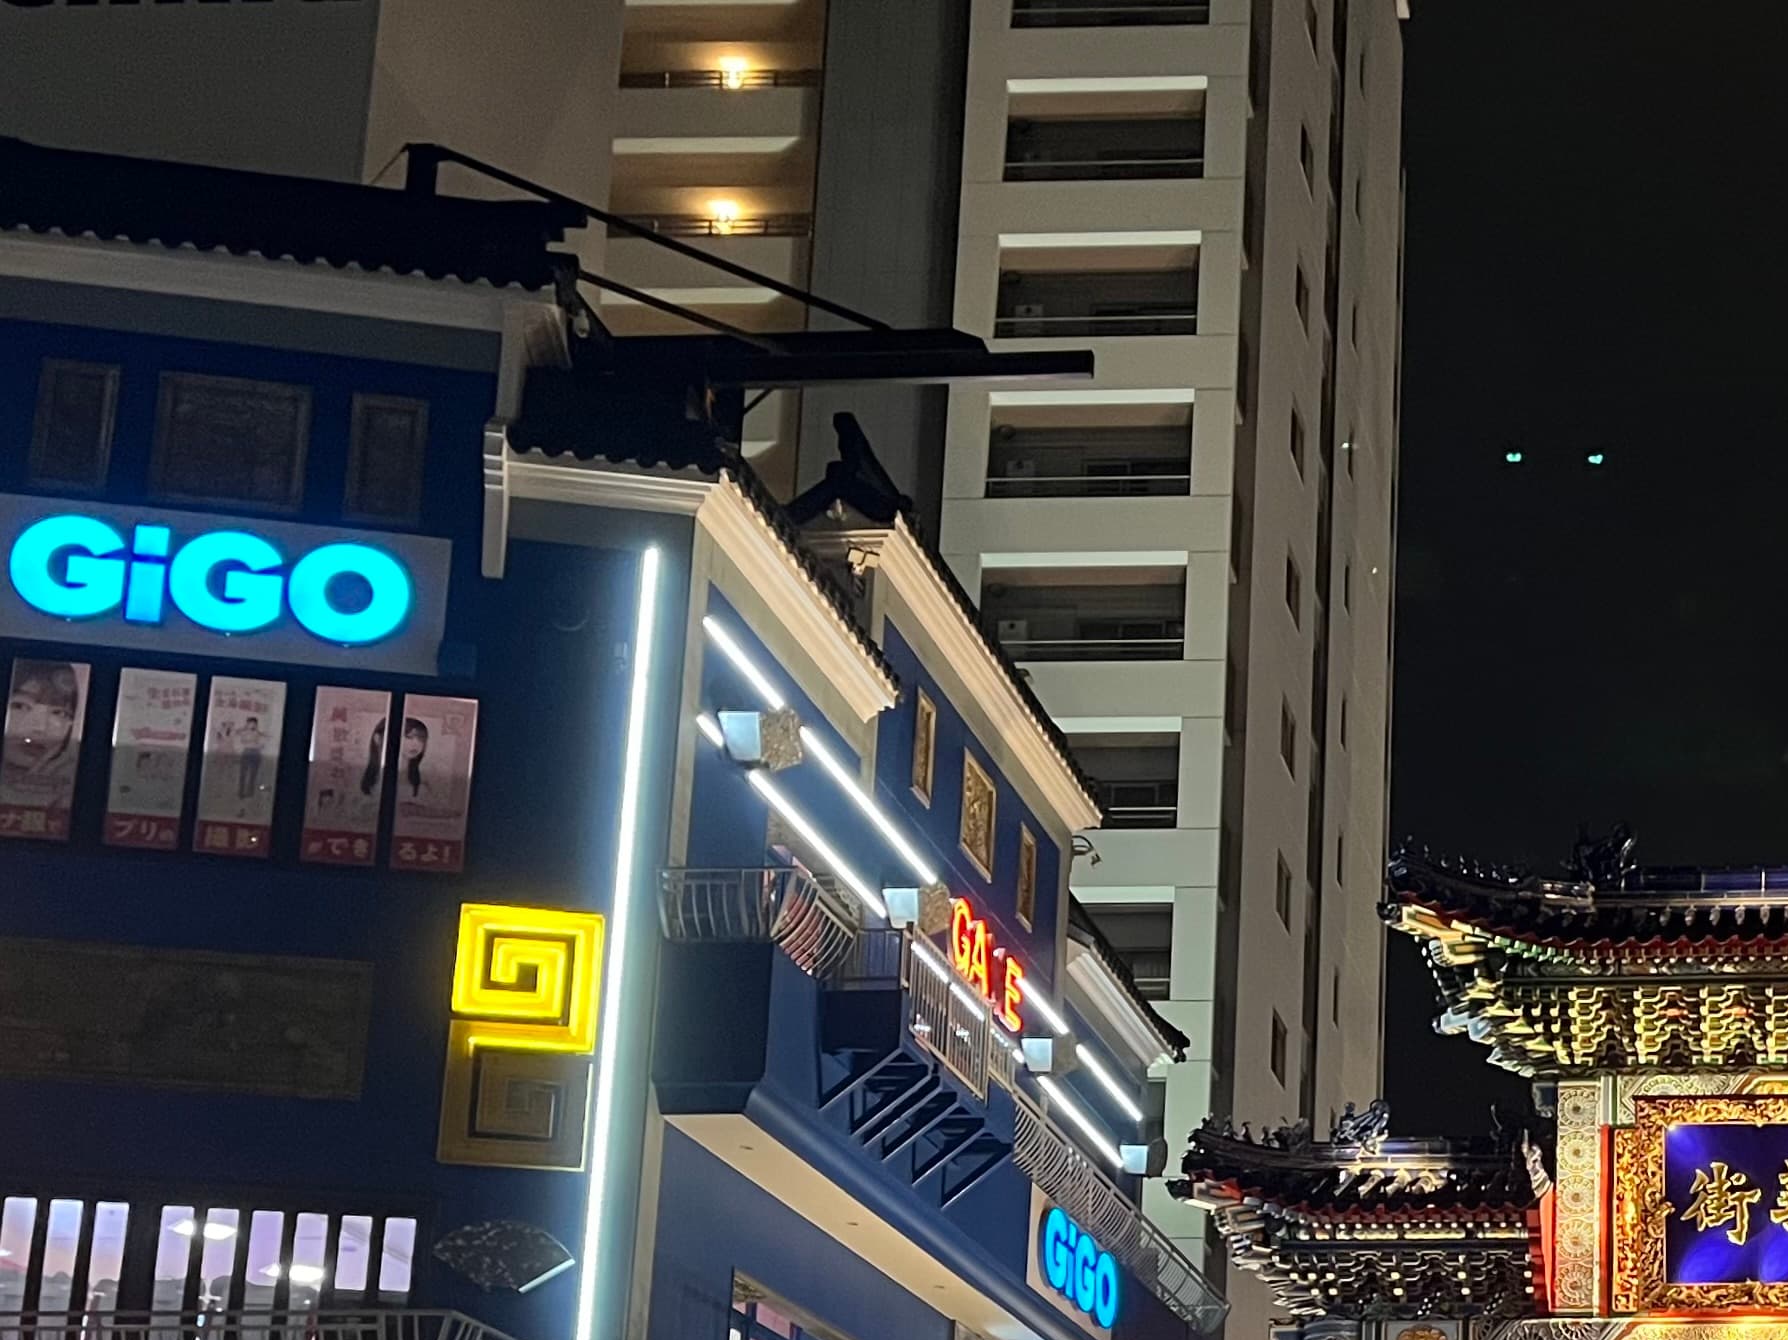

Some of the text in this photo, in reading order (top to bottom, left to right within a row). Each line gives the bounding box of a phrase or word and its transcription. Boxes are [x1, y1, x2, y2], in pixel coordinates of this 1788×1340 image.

[10, 514, 412, 647] GiGO
[950, 896, 1024, 1033] GAE
[1043, 1206, 1120, 1329] GiGO
